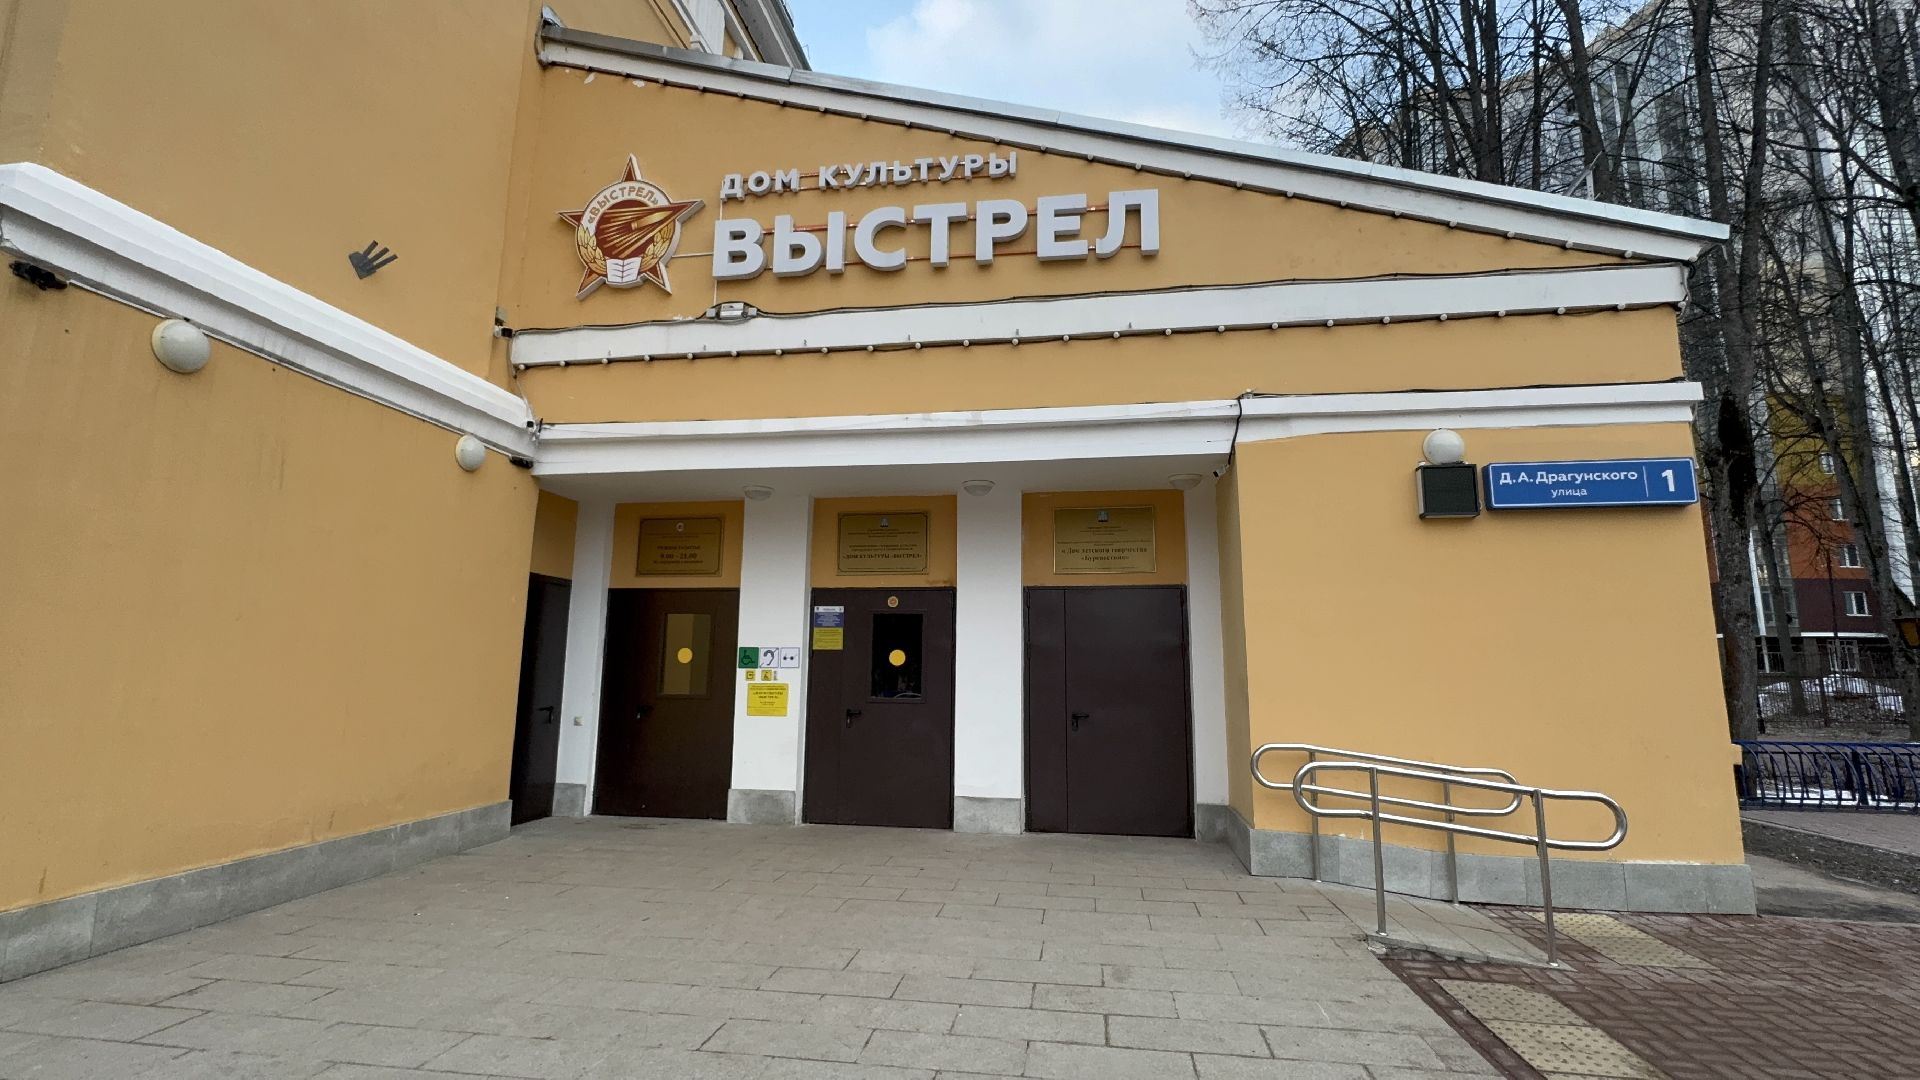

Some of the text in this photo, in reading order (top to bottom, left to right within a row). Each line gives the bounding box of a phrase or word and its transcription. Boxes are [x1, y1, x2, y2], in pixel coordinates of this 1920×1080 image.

[720, 151, 1018, 200] ДОМ КУЛЬТУРЫ
[587, 185, 659, 224] «ВЫСТРЕЛ»
[712, 188, 1160, 281] ВЫСТРЕЛ
[1551, 488, 1588, 498] улица
[1661, 469, 1676, 492] 1
